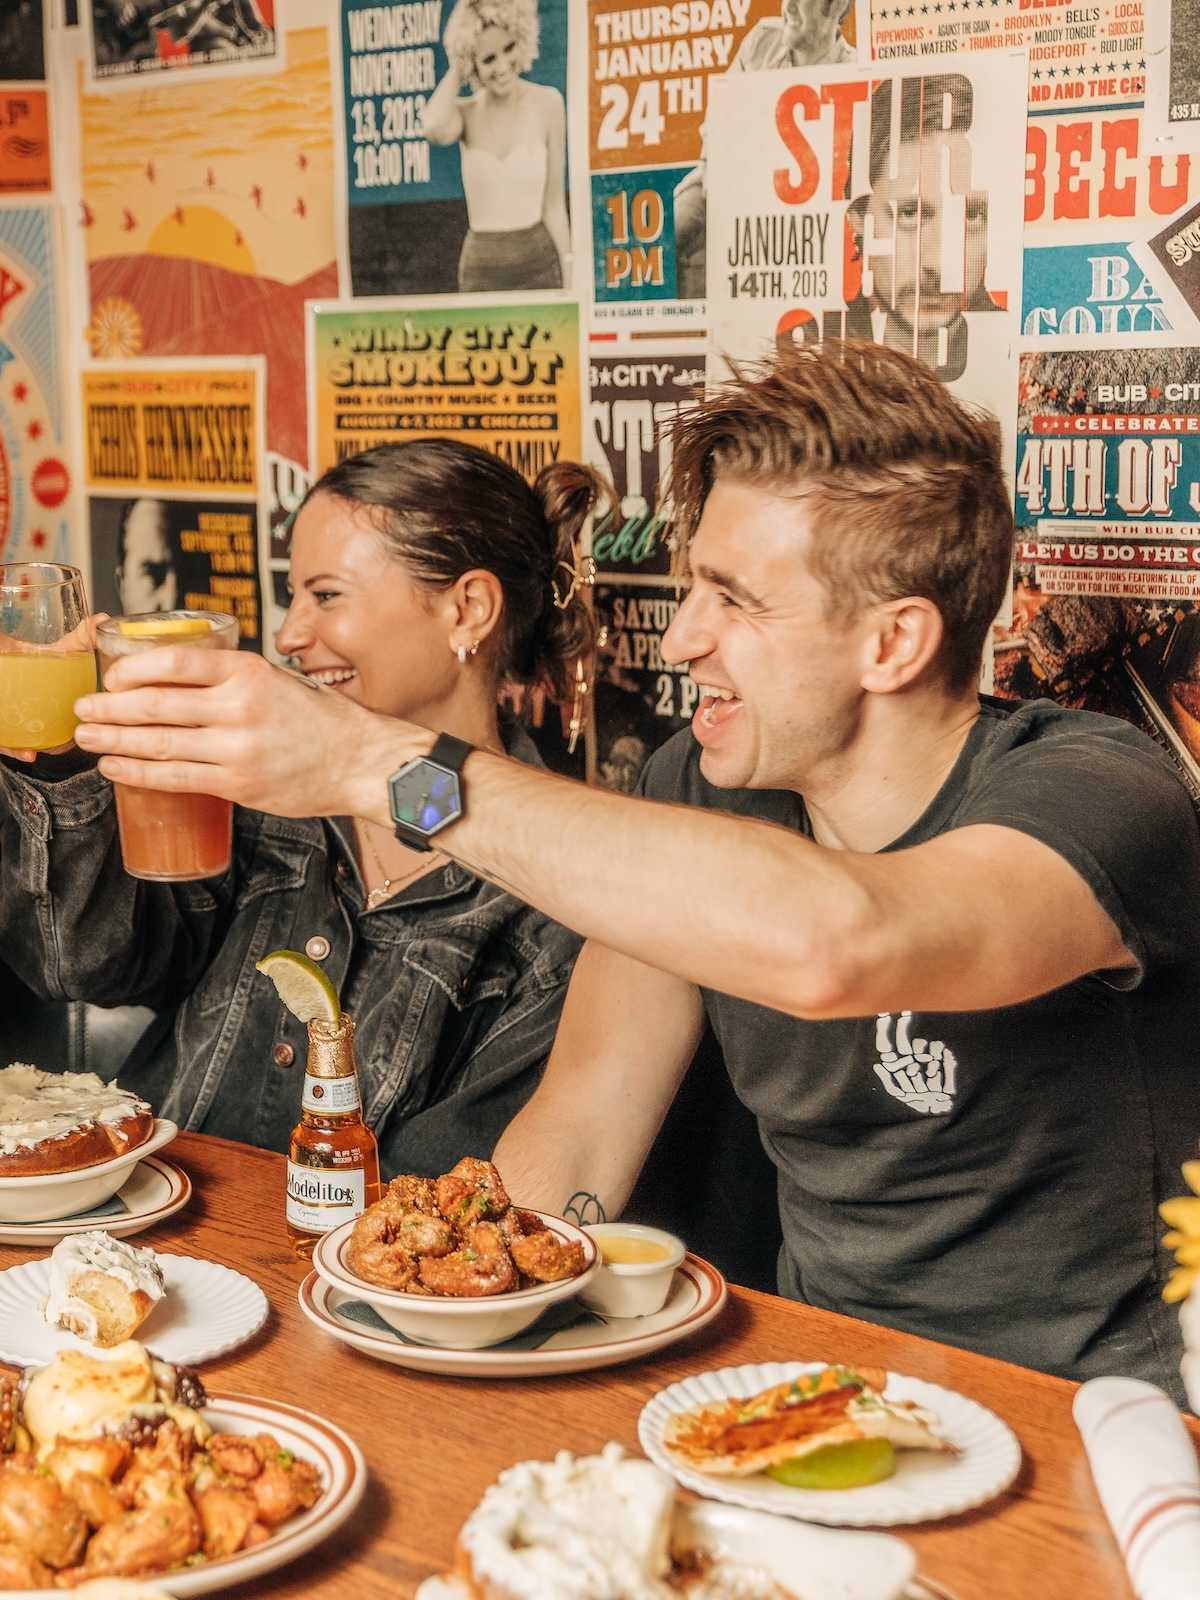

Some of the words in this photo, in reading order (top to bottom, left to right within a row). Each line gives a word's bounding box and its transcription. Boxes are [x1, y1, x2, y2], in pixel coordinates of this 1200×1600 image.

[348, 2, 442, 50] WEDNESDAY
[594, 0, 752, 44] THURSDAY
[875, 26, 925, 43] PIPEWORKS
[937, 22, 960, 37] AGAINST
[961, 21, 972, 35] THE
[972, 19, 991, 33] GRAIN
[1004, 14, 1052, 30] BROOKLYN
[1066, 7, 1100, 23] BELL'S
[1114, 3, 1144, 18] LOCAL
[594, 32, 738, 80] JANUARY
[878, 42, 919, 60] CENTRAL
[921, 40, 958, 56] WATERS
[969, 34, 1005, 50] TRUMER
[1005, 33, 1024, 47] PILS
[1034, 29, 1063, 44] MOODY
[1065, 25, 1097, 41] TONGUE
[1108, 22, 1128, 36] GOOSE
[1100, 39, 1118, 53] BUD
[1120, 37, 1144, 52] LIGHT
[351, 47, 436, 97] NOVEMBER
[1054, 81, 1085, 100] AND
[1088, 78, 1117, 97] THE
[383, 95, 427, 140] 2013
[597, 76, 702, 150] 24TH
[1170, 103, 1189, 119] 435
[353, 144, 401, 188] 10:00
[402, 141, 431, 183] PM
[607, 188, 664, 244] 10
[728, 214, 829, 267] JANUARY
[606, 245, 664, 289] PM
[728, 270, 787, 300] 14TH,
[791, 269, 828, 298] 2013
[351, 326, 452, 353] WINDY
[463, 324, 538, 351] CITY
[330, 351, 563, 387] SMOKEOUT
[612, 363, 671, 388] CITY
[377, 393, 443, 405] COUNTRY
[448, 393, 498, 405] MUSIC
[517, 392, 557, 405] BEER
[1097, 384, 1147, 402] BUB
[479, 414, 553, 428] CHICAGO
[1074, 417, 1200, 431] CELEBRATE
[1016, 438, 1107, 516] 4TH
[1116, 438, 1182, 517] OF
[1103, 525, 1138, 535] WITH
[1145, 526, 1174, 535] BUB
[1021, 543, 1065, 559] LET
[1069, 544, 1100, 560] US
[1103, 545, 1135, 561] DO
[1139, 546, 1189, 563] THE
[1040, 569, 1057, 580] WITH
[1059, 569, 1095, 581] CATERING
[1096, 570, 1126, 582] OPTIONS
[1128, 572, 1168, 584] FEATURING
[1171, 574, 1184, 585] ALL
[1187, 575, 1197, 585] OF
[1046, 581, 1055, 591] OR
[1057, 581, 1076, 592] STOP
[1078, 582, 1087, 593] BY
[1088, 583, 1102, 594] FOR
[1104, 583, 1121, 594] LIVE
[1123, 584, 1146, 595] MUSIC
[1148, 584, 1167, 596] WITH
[1169, 585, 1190, 597] FOOD
[615, 632, 689, 672] APR
[656, 673, 674, 717] 2
